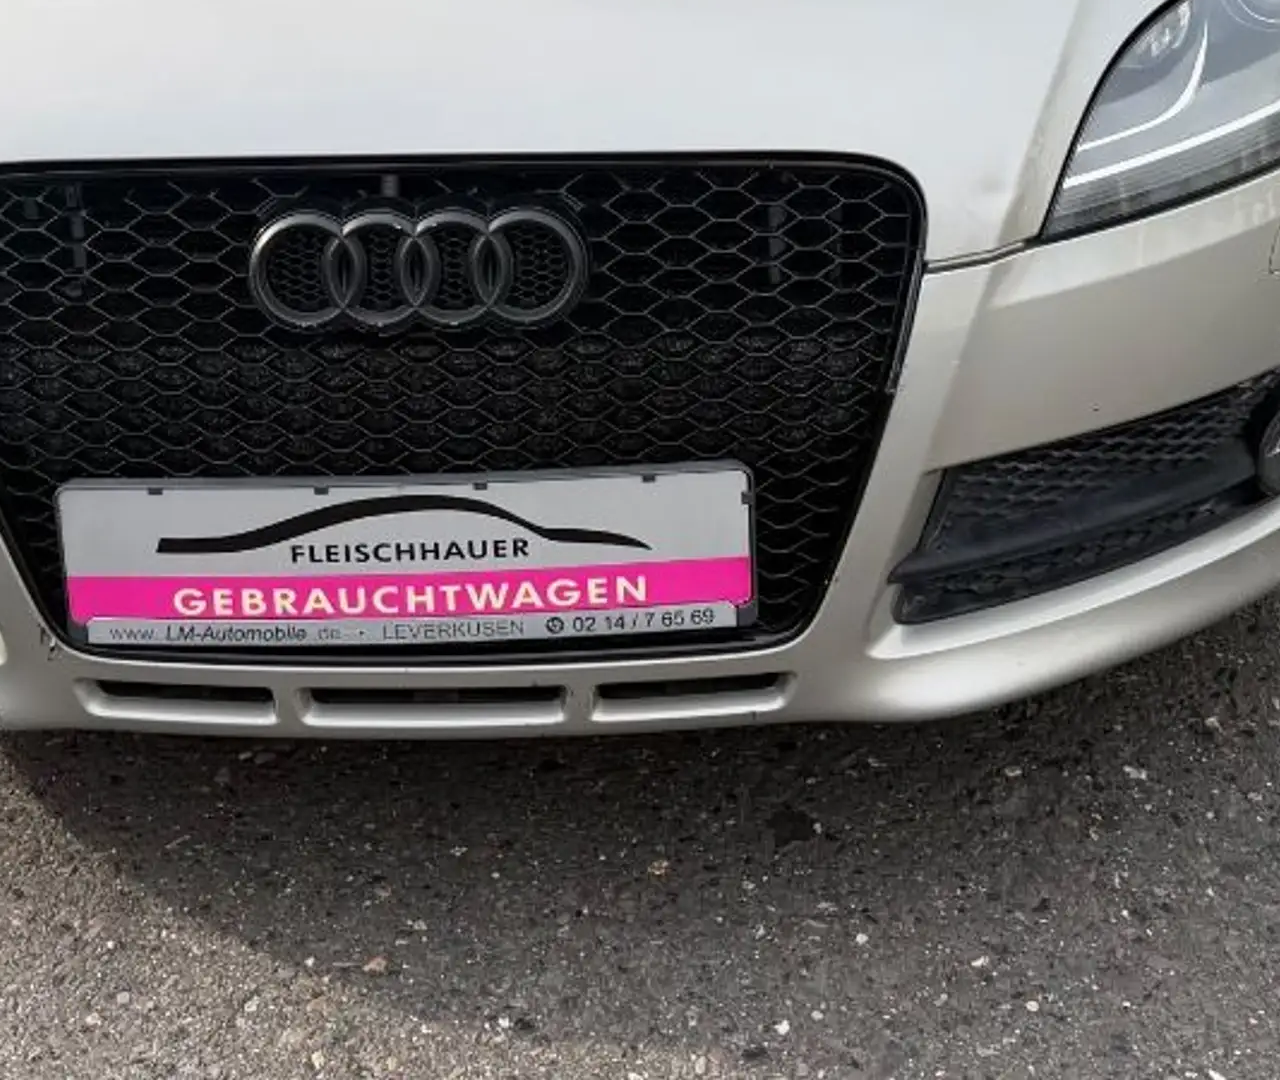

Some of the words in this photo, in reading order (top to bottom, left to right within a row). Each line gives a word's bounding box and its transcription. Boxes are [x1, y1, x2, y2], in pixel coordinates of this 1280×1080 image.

[290, 539, 530, 565] FLEISCHHAUER
[172, 575, 648, 618] GEBRAUCHTWAGEN
[382, 620, 524, 641] LEVERKUSEN
